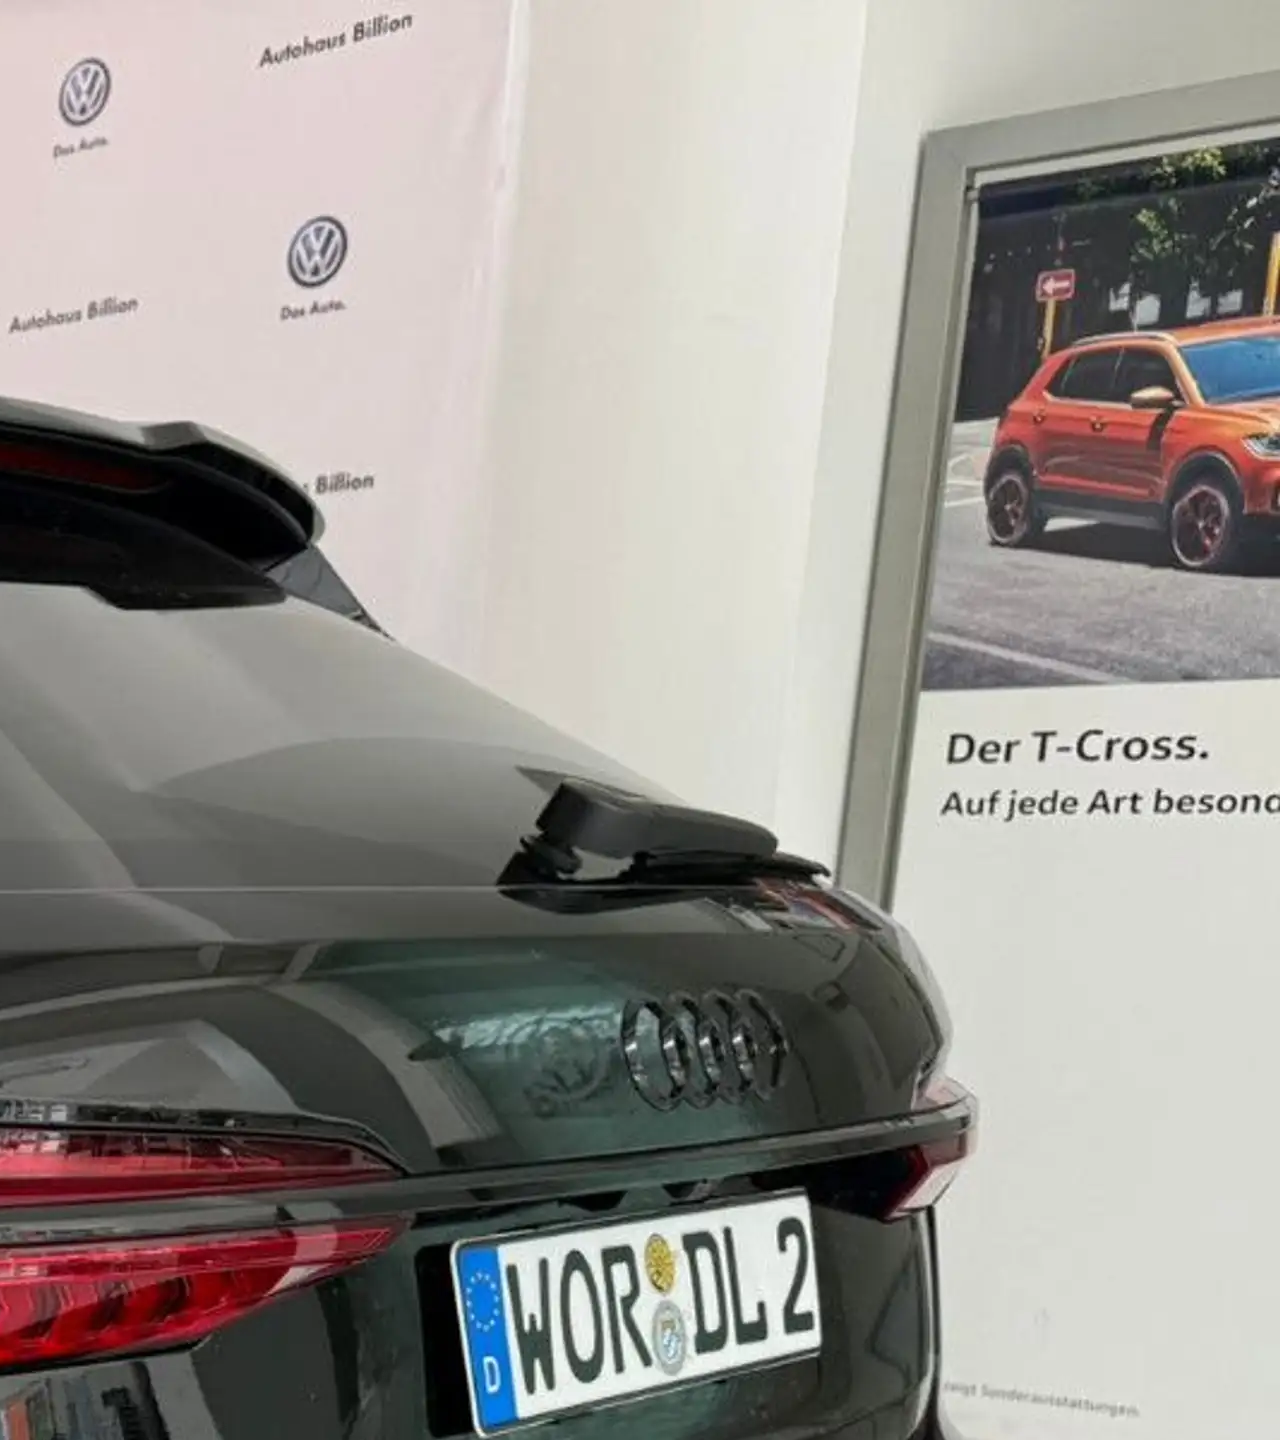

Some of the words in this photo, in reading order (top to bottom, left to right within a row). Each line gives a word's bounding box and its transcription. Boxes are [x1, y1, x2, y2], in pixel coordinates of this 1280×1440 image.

[260, 32, 346, 68] Autohaus
[353, 14, 413, 43] Billion
[8, 308, 82, 334] Autohaus
[87, 296, 139, 320] Billion
[315, 471, 375, 495] Billion
[945, 732, 1022, 766] Der
[1030, 728, 1210, 765] T-Cross.
[939, 789, 1002, 817] Auf
[1004, 788, 1080, 823] jede
[1086, 788, 1144, 816] Art
[506, 1244, 653, 1396] WOR
[682, 1227, 769, 1355] DL
[777, 1217, 815, 1337] 2
[482, 1355, 501, 1394] D
